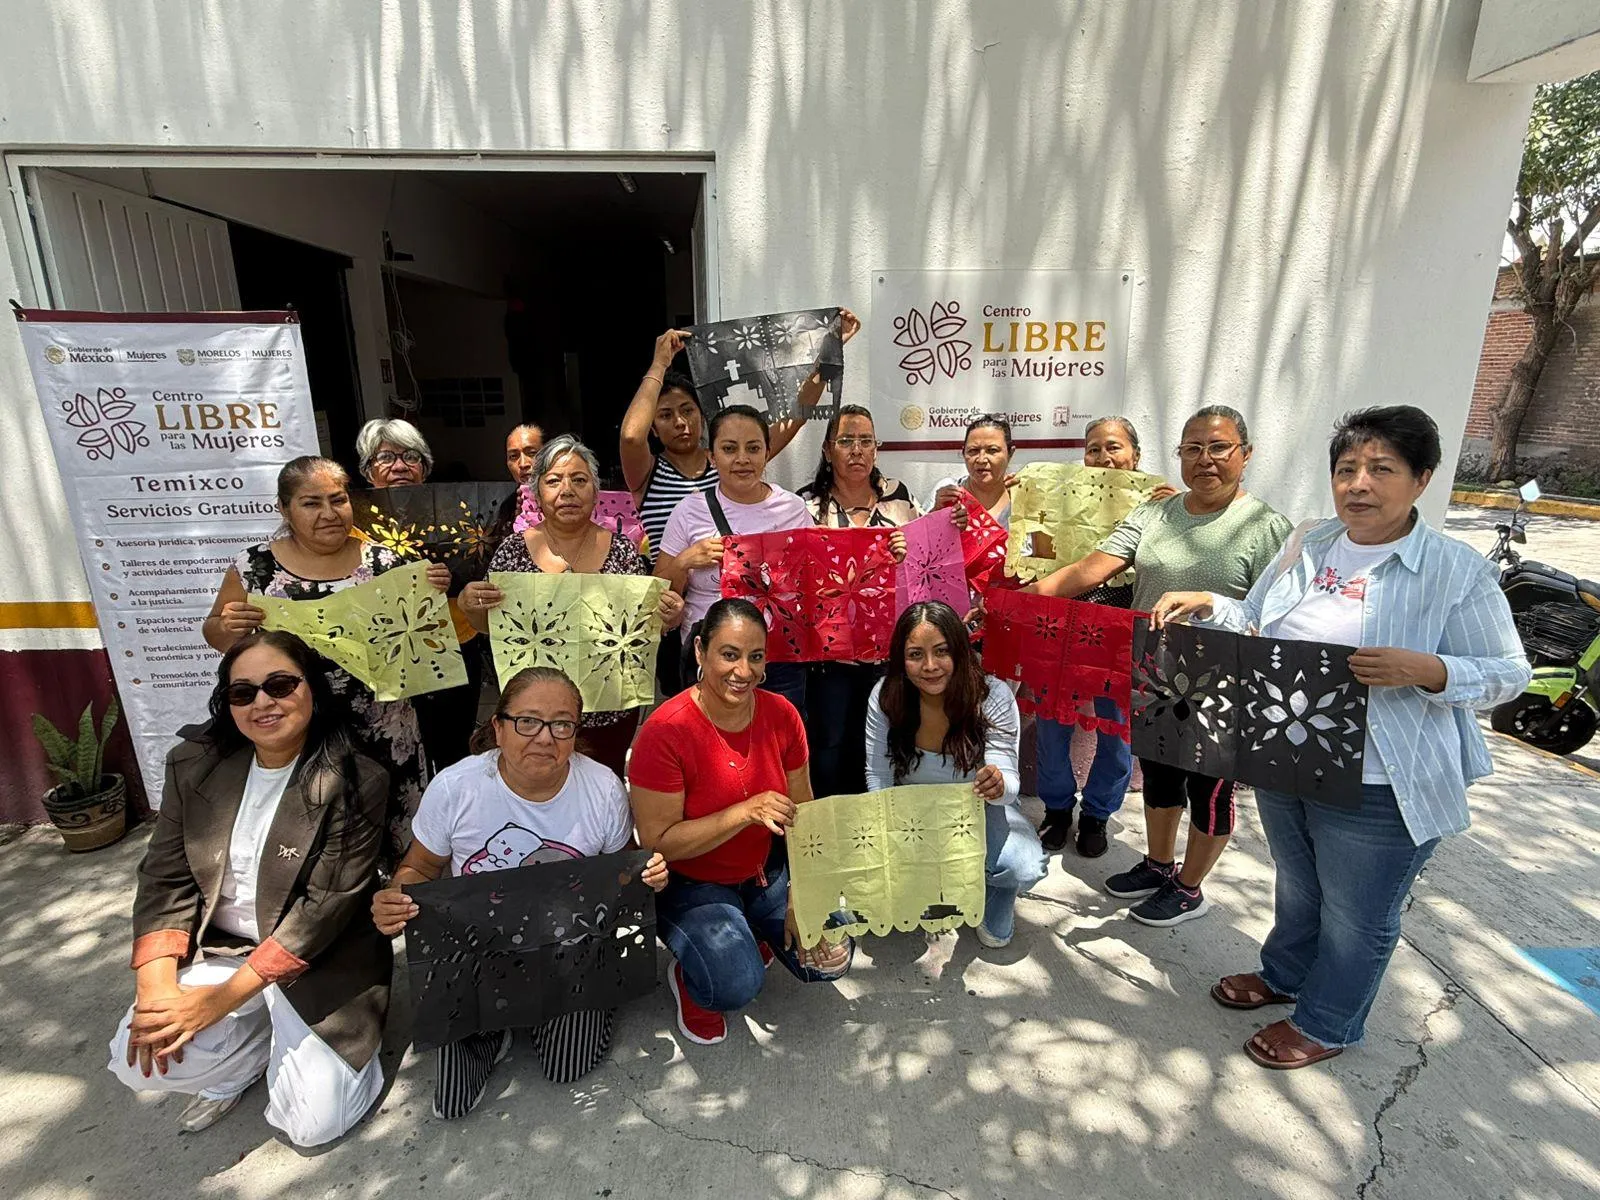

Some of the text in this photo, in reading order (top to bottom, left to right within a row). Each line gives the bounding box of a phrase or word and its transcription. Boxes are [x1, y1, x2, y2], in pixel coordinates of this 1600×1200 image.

[983, 304, 1031, 317] Centro
[982, 321, 1106, 353] LIBRE
[70, 353, 114, 363] México
[126, 351, 167, 360] Mujeres
[197, 349, 241, 357] MORELOS
[252, 349, 292, 357] MUJERES
[983, 358, 1007, 369] para
[991, 356, 1104, 382] las Mujeres
[152, 390, 204, 402] Centro
[928, 406, 968, 414] Gobierno
[155, 402, 281, 431] LIBRE
[928, 415, 973, 428] Méxic
[1003, 412, 1041, 424] ujeres
[160, 432, 186, 443] para
[170, 430, 285, 453] las Mujeres
[131, 474, 244, 493] Temixco
[107, 504, 192, 519] Servicios
[198, 535, 269, 546] psicoemocional
[120, 559, 157, 567] Talleres
[158, 558, 171, 566] de
[131, 568, 184, 577] actividades
[129, 587, 208, 598] Acompañamiento
[138, 598, 147, 606] la
[148, 597, 184, 607] justicia.
[136, 616, 175, 626] Espacios
[151, 626, 194, 634] violencia.
[146, 653, 194, 662] económica
[195, 654, 202, 662] y
[150, 671, 199, 680] Promoción
[152, 680, 213, 689] comunitarios.
